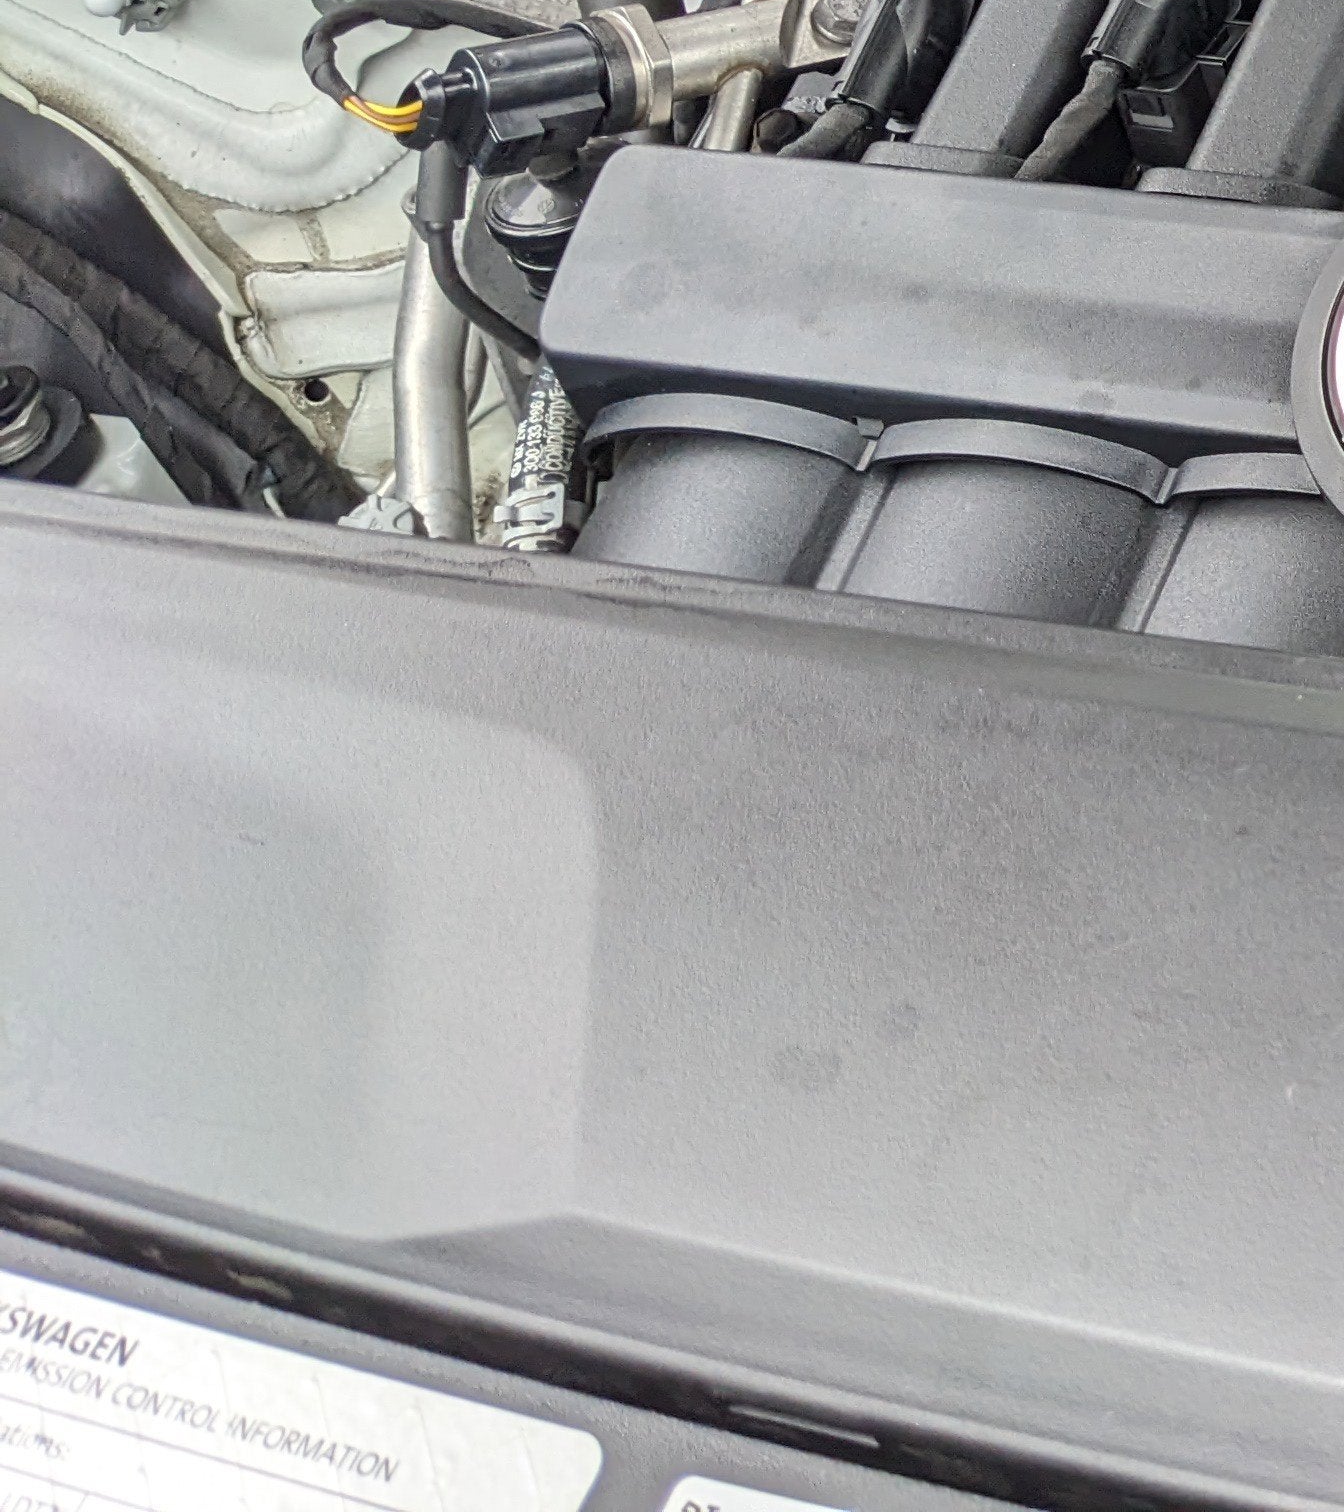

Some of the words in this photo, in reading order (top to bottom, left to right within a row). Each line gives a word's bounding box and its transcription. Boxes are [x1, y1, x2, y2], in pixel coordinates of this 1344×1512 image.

[545, 388, 567, 471] CONDUCTIVE
[111, 1382, 220, 1433] CONTROL
[226, 1413, 400, 1483] INFORMATION
